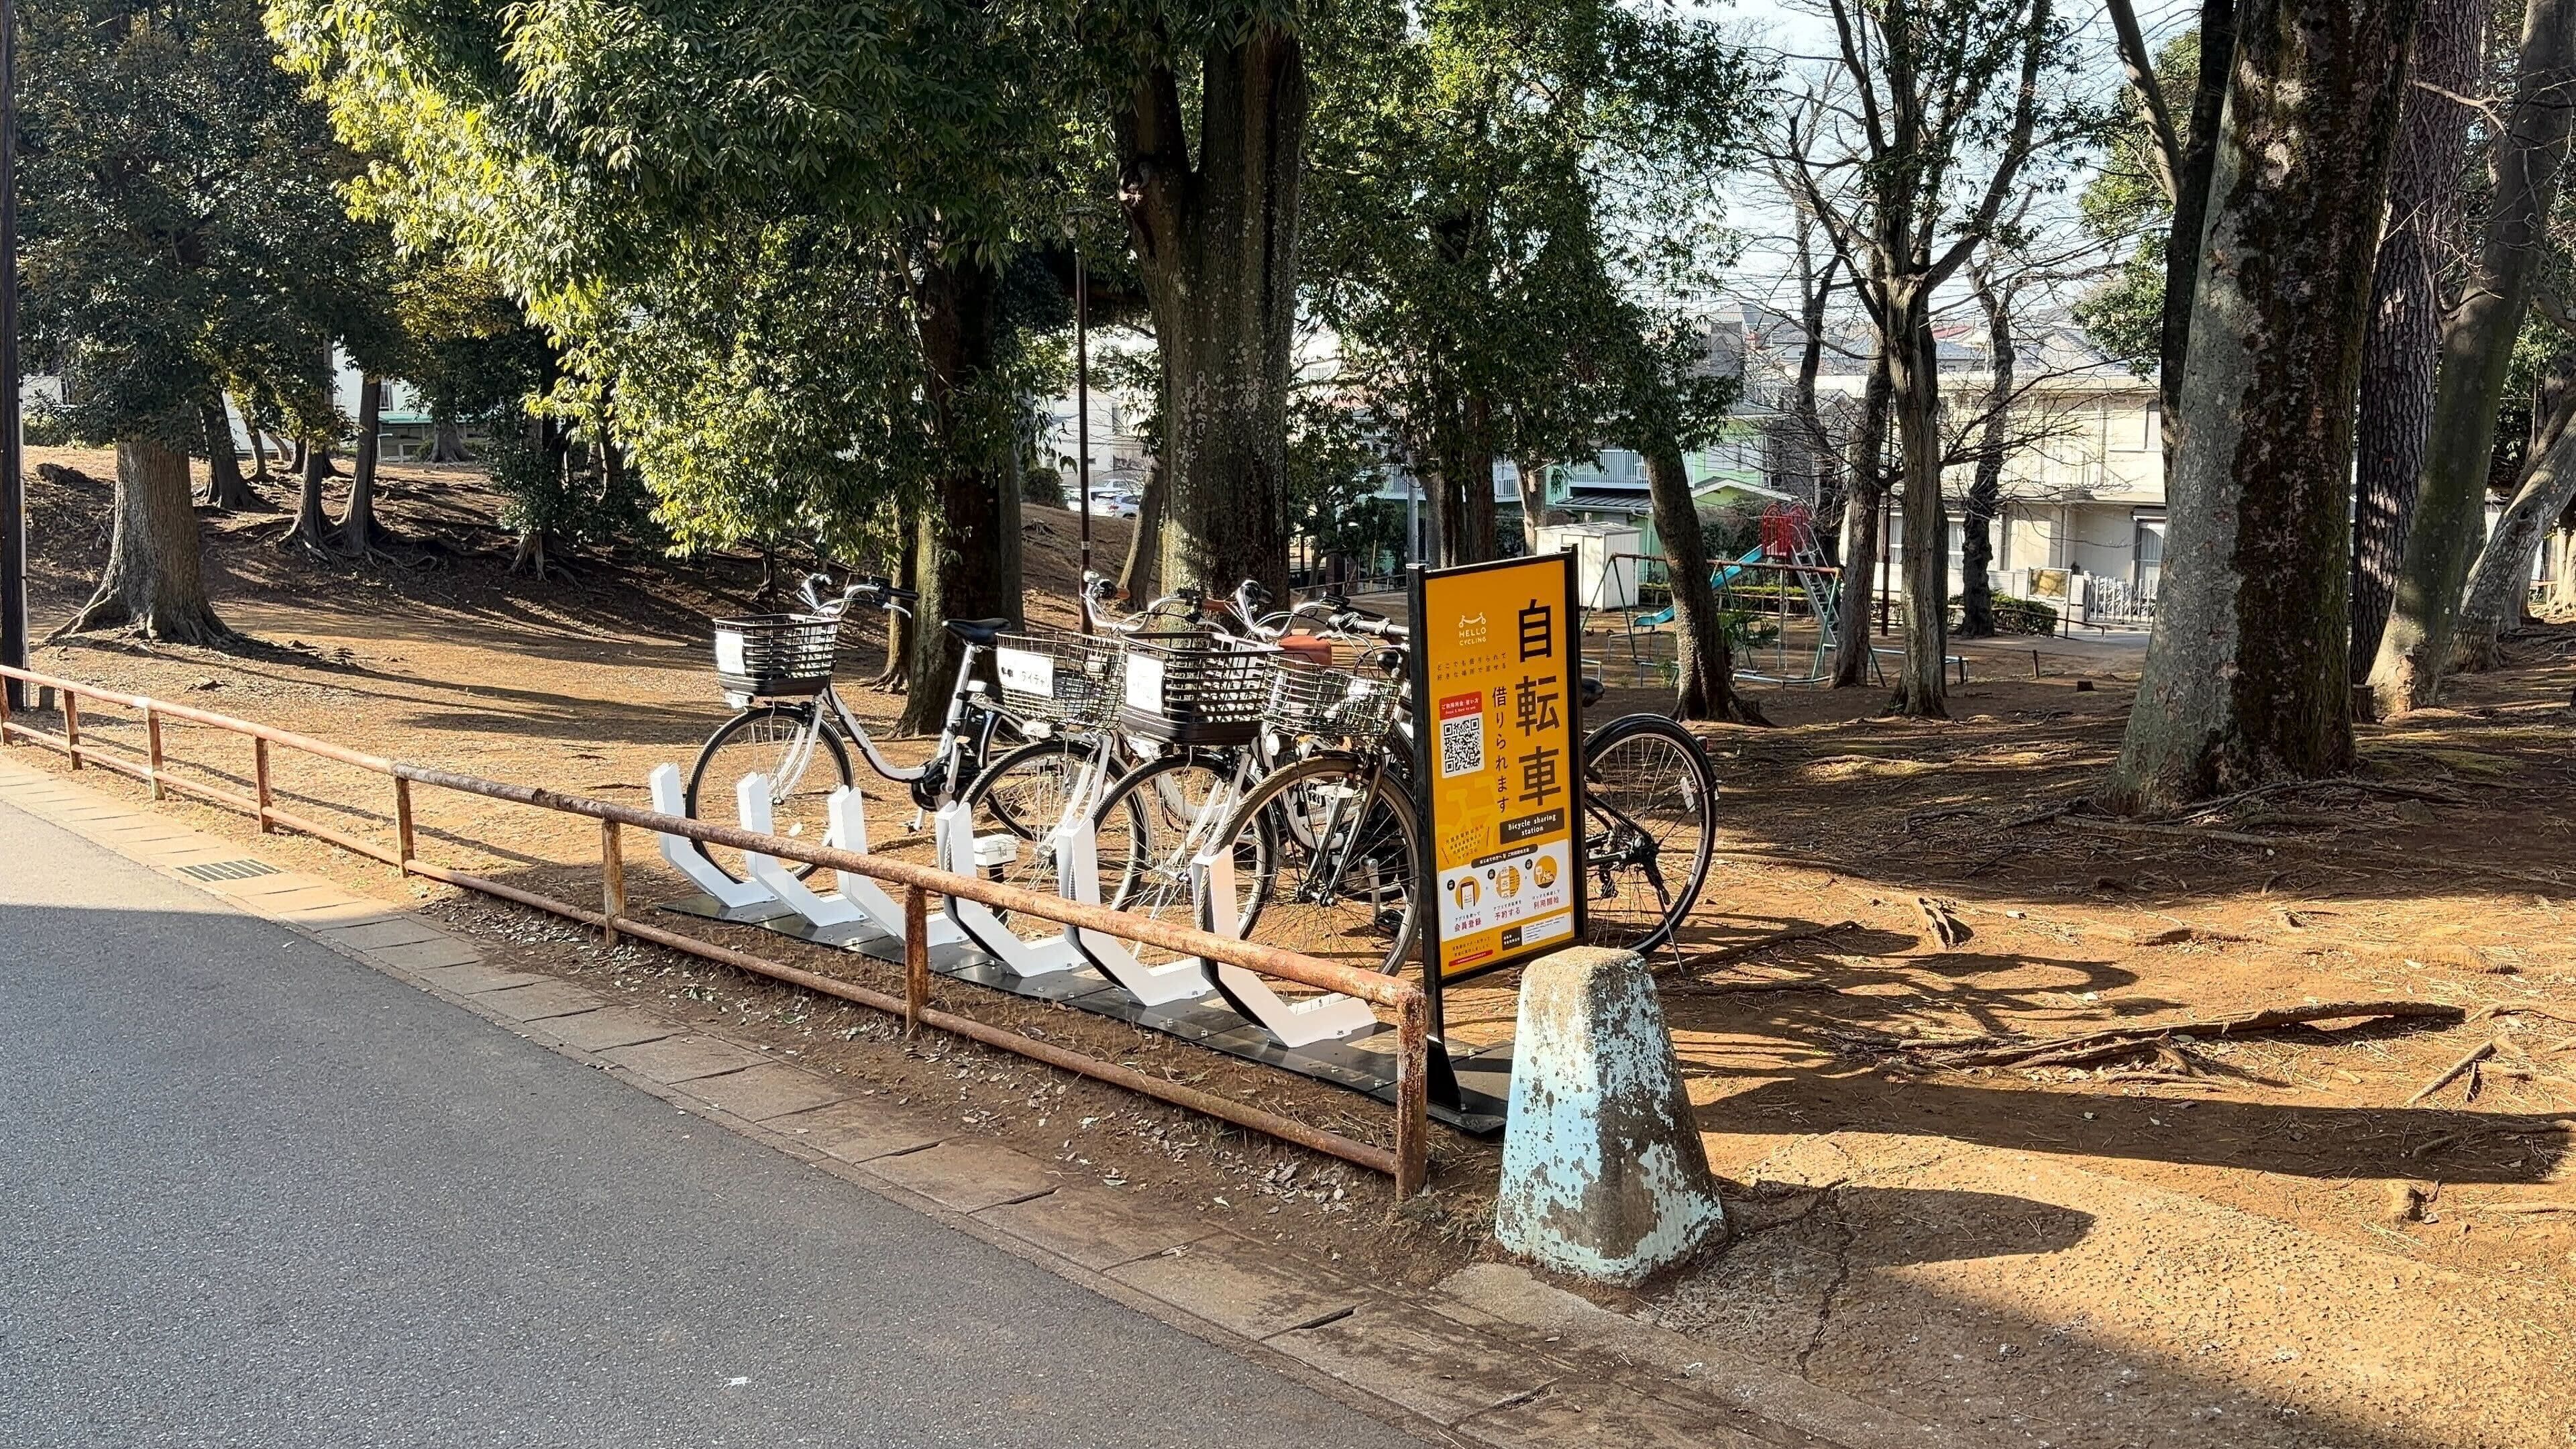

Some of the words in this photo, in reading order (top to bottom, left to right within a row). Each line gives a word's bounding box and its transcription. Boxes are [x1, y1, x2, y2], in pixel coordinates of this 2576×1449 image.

[1459, 627, 1487, 638] HELLO
[1459, 636, 1487, 646] CYCLING
[1515, 599, 1561, 806] 自転車
[1492, 686, 1509, 813] 借りられます
[1508, 819, 1531, 831] Bicycle
[1534, 814, 1556, 824] sharing
[1521, 826, 1544, 837] station
[1534, 896, 1560, 910] 利用開始
[1494, 907, 1521, 921] 予約する
[1454, 918, 1481, 932] 会員登録
